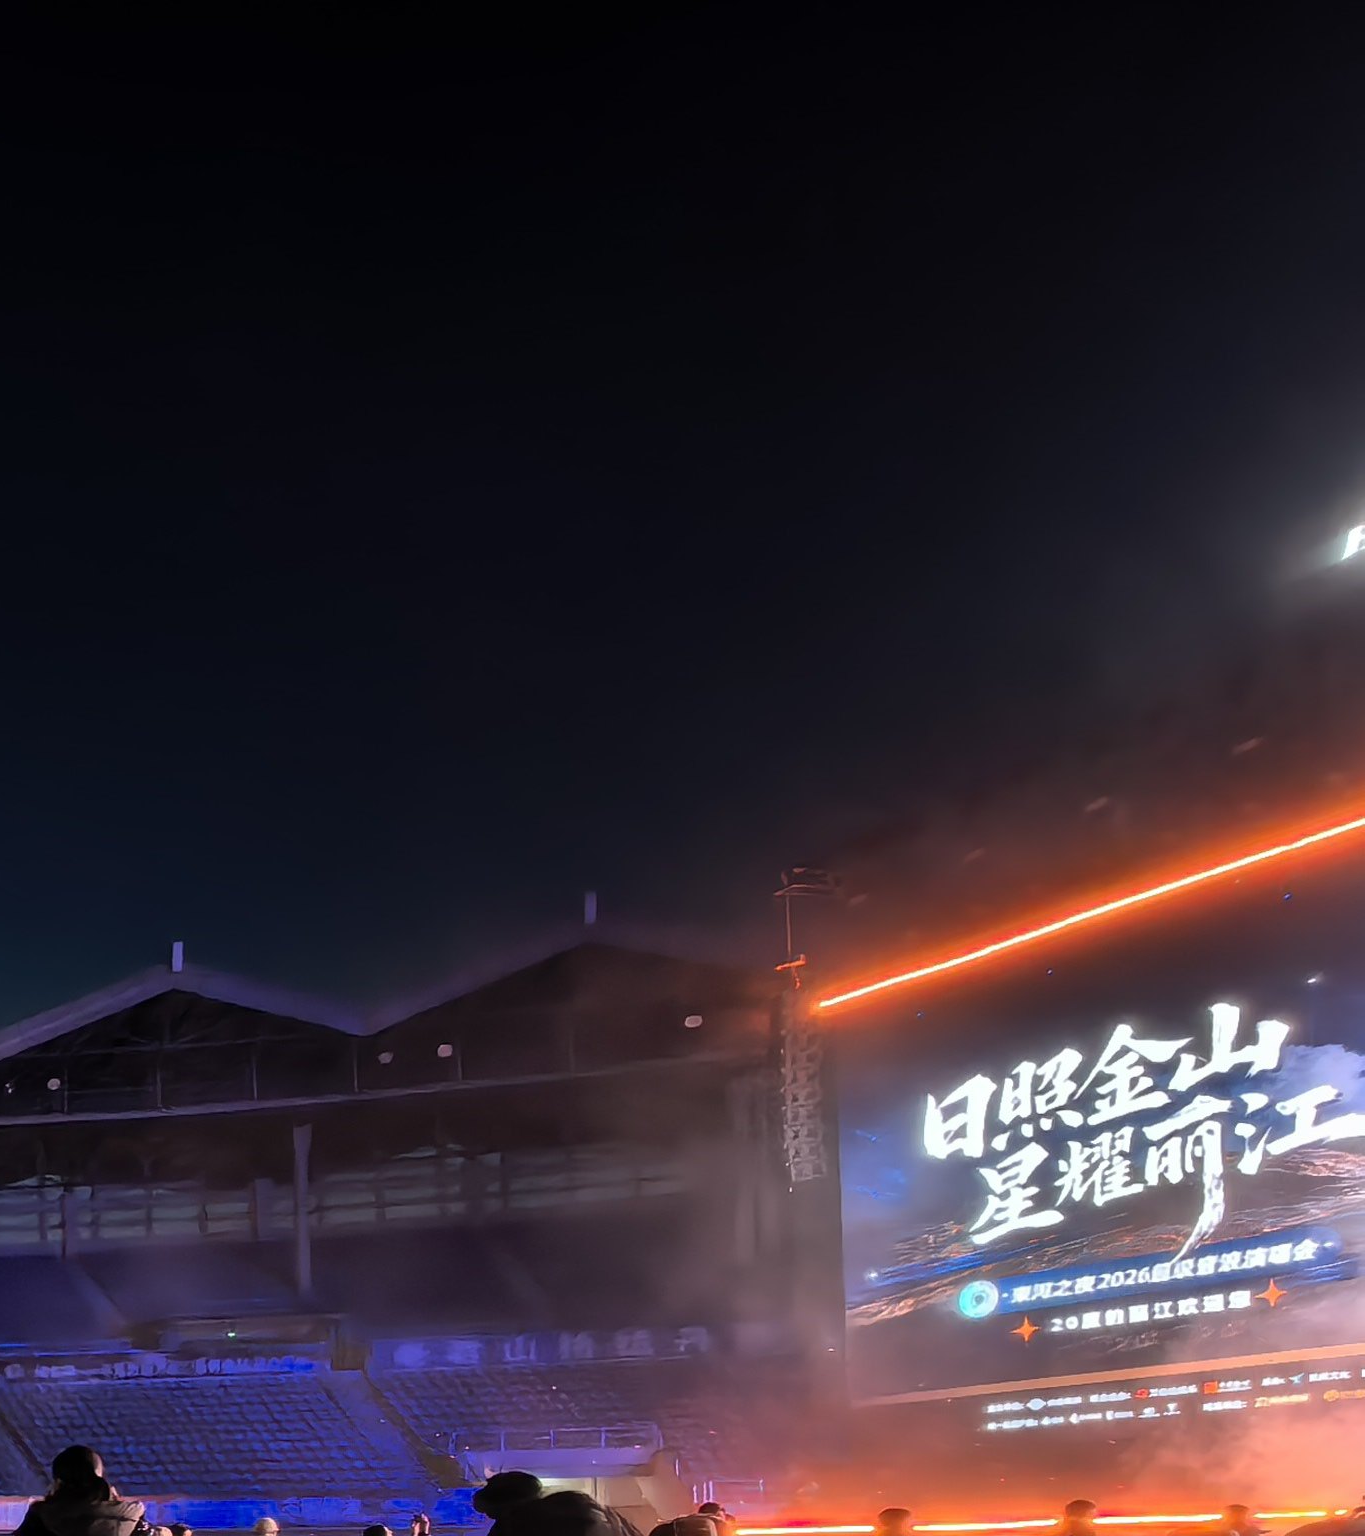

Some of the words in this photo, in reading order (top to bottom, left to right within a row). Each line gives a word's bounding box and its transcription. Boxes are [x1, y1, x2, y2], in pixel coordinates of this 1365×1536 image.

[921, 1003, 1291, 1159] 日照金山
[968, 1084, 1365, 1263] 星耀丽江
